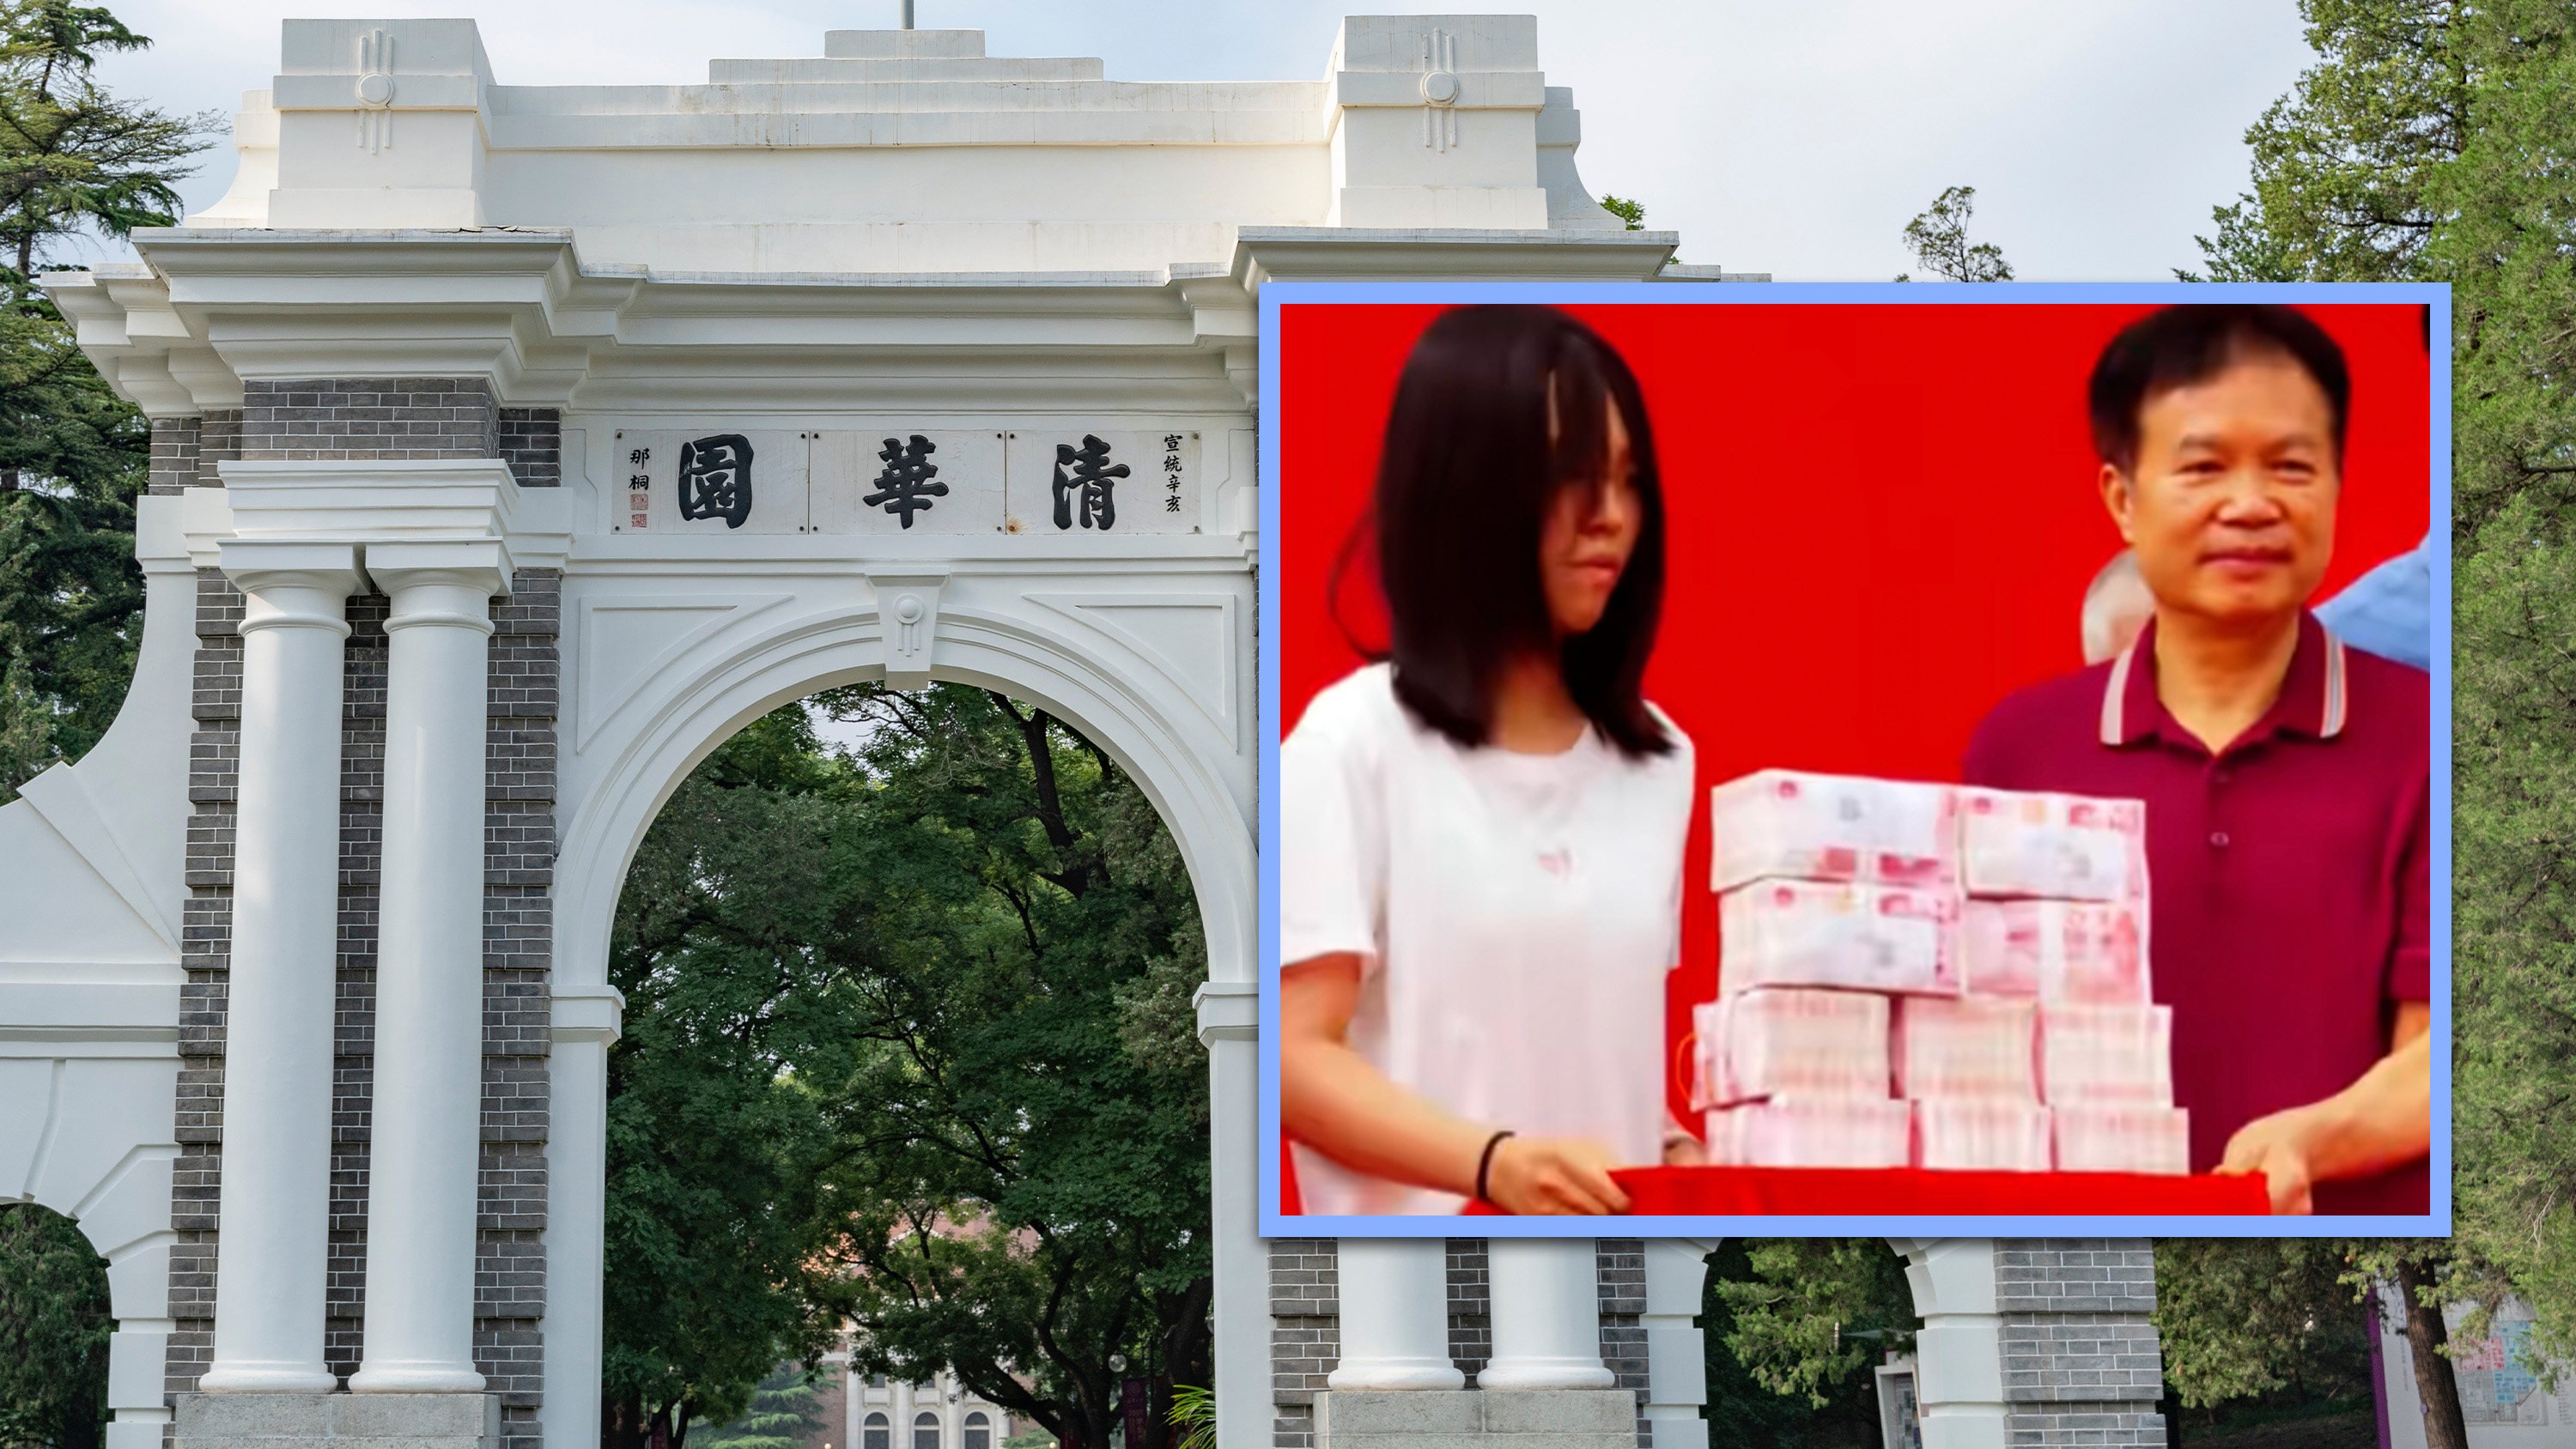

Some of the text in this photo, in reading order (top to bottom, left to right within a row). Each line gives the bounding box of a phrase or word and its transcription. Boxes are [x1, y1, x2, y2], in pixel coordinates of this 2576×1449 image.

[629, 447, 650, 490] 那桐
[1163, 433, 1183, 512] 宣統辛亥
